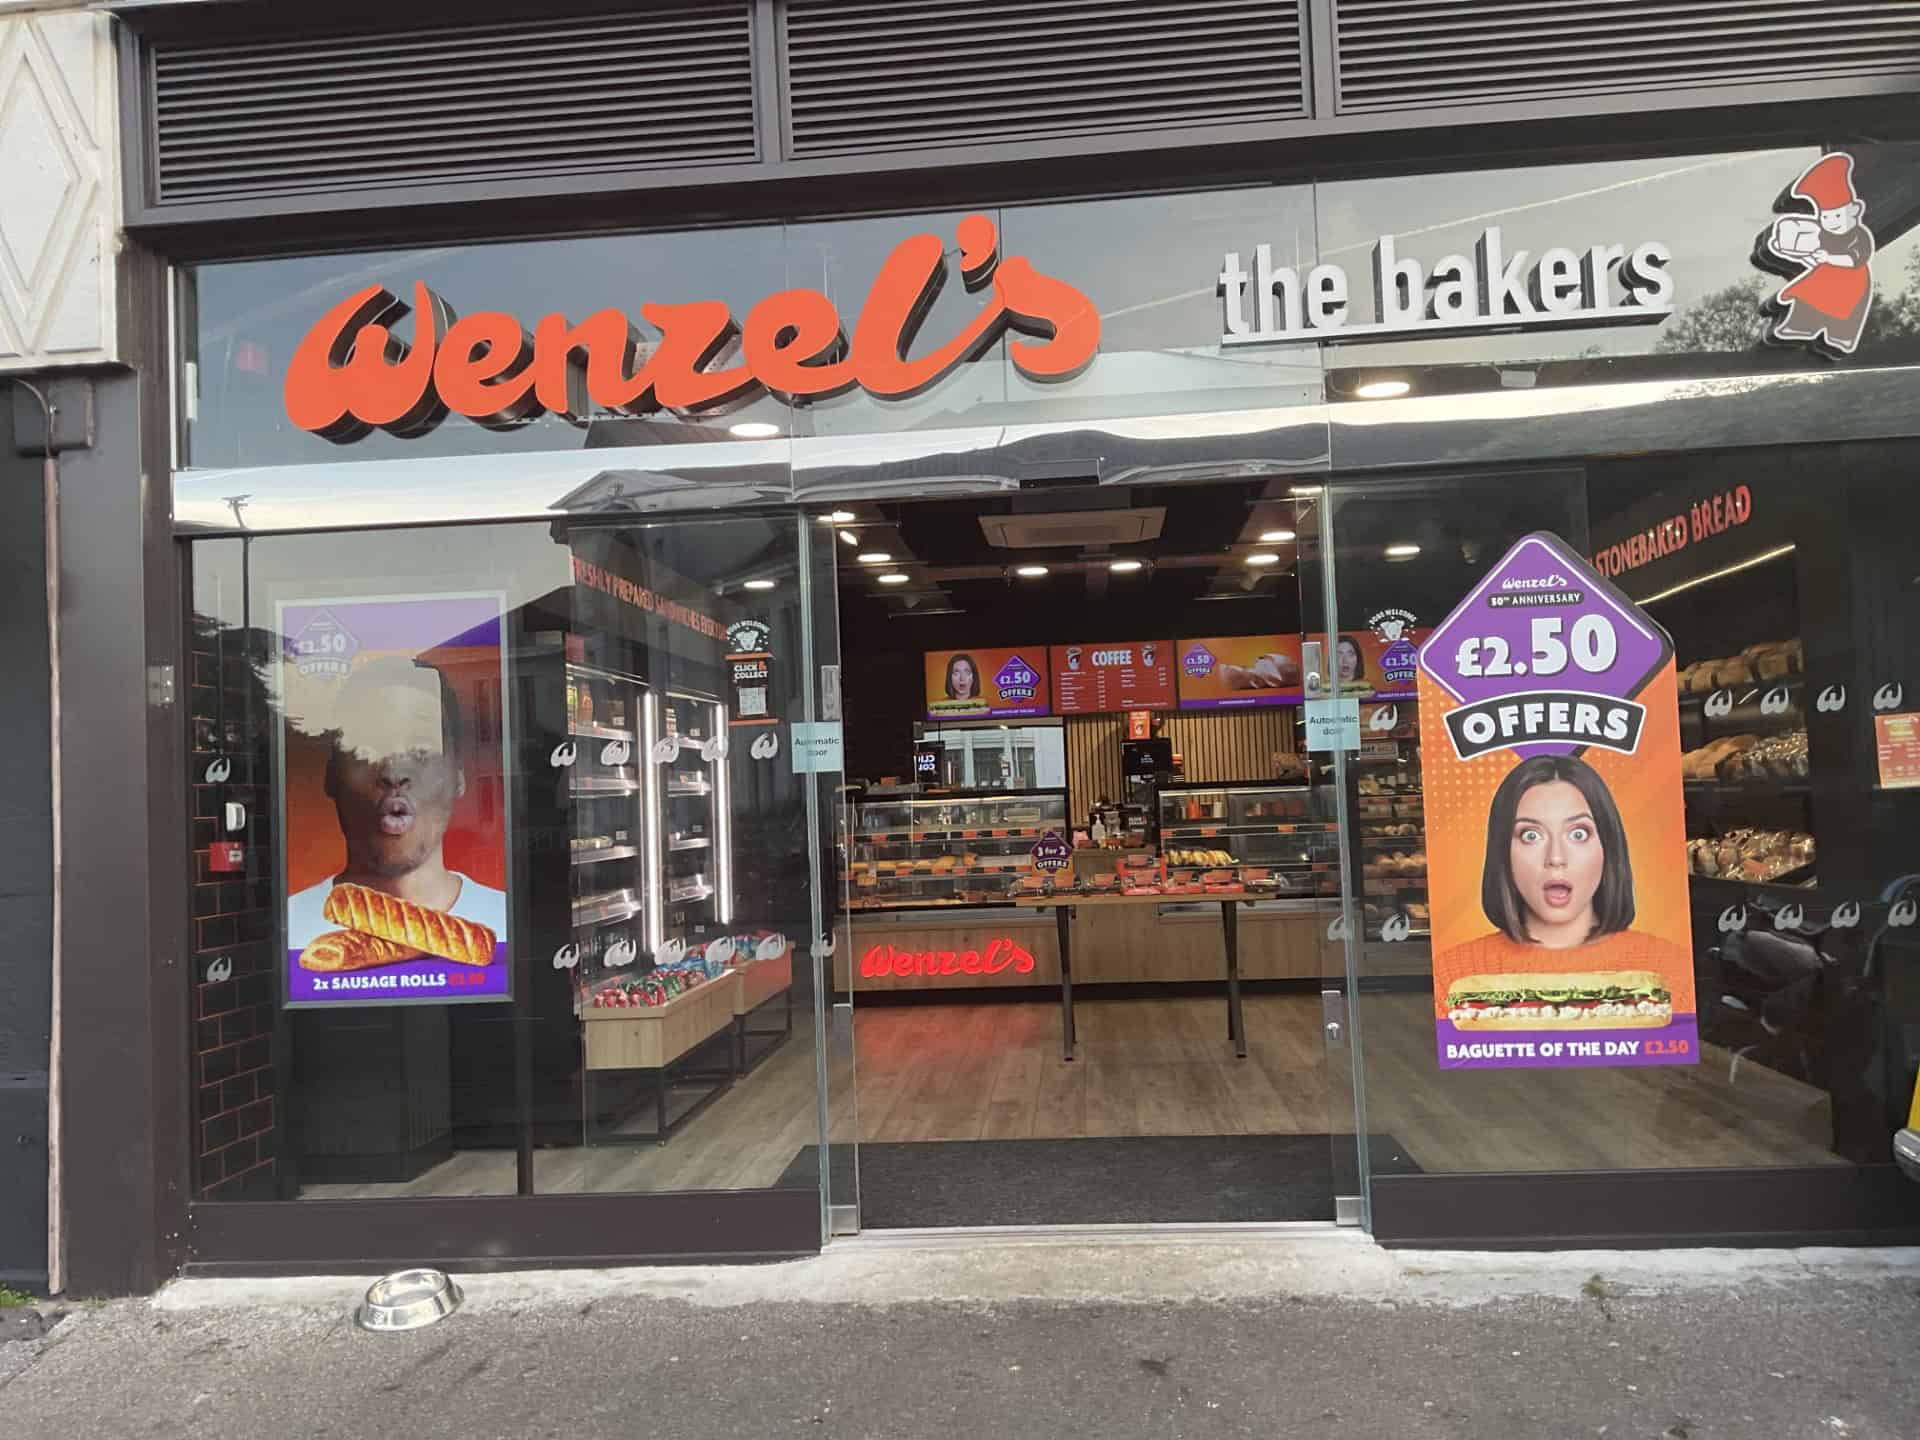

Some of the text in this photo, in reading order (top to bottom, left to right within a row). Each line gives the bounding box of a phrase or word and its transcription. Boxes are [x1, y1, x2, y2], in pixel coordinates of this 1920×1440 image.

[1218, 226, 1673, 334] the bakers
[285, 214, 1101, 436] Wenzel's
[1596, 485, 1752, 576] STONEBAKED BREAD
[1502, 574, 1568, 590] Wenzel's
[1511, 593, 1581, 606] ANNIVERSARY
[1456, 613, 1617, 678] £2.50
[1091, 649, 1132, 666] COFFEE
[734, 664, 758, 672] CLICK
[734, 670, 769, 680] COLLECT
[1462, 702, 1630, 744] OFFERS
[1037, 860, 1067, 868] OFFERS
[860, 938, 1035, 978] Wenzel's
[313, 978, 329, 991] 2x
[331, 975, 397, 990] SAUSAGE
[400, 973, 446, 988] ROLLS
[1446, 1040, 1688, 1058] BAGUETTE OF THE DAY £2.50
